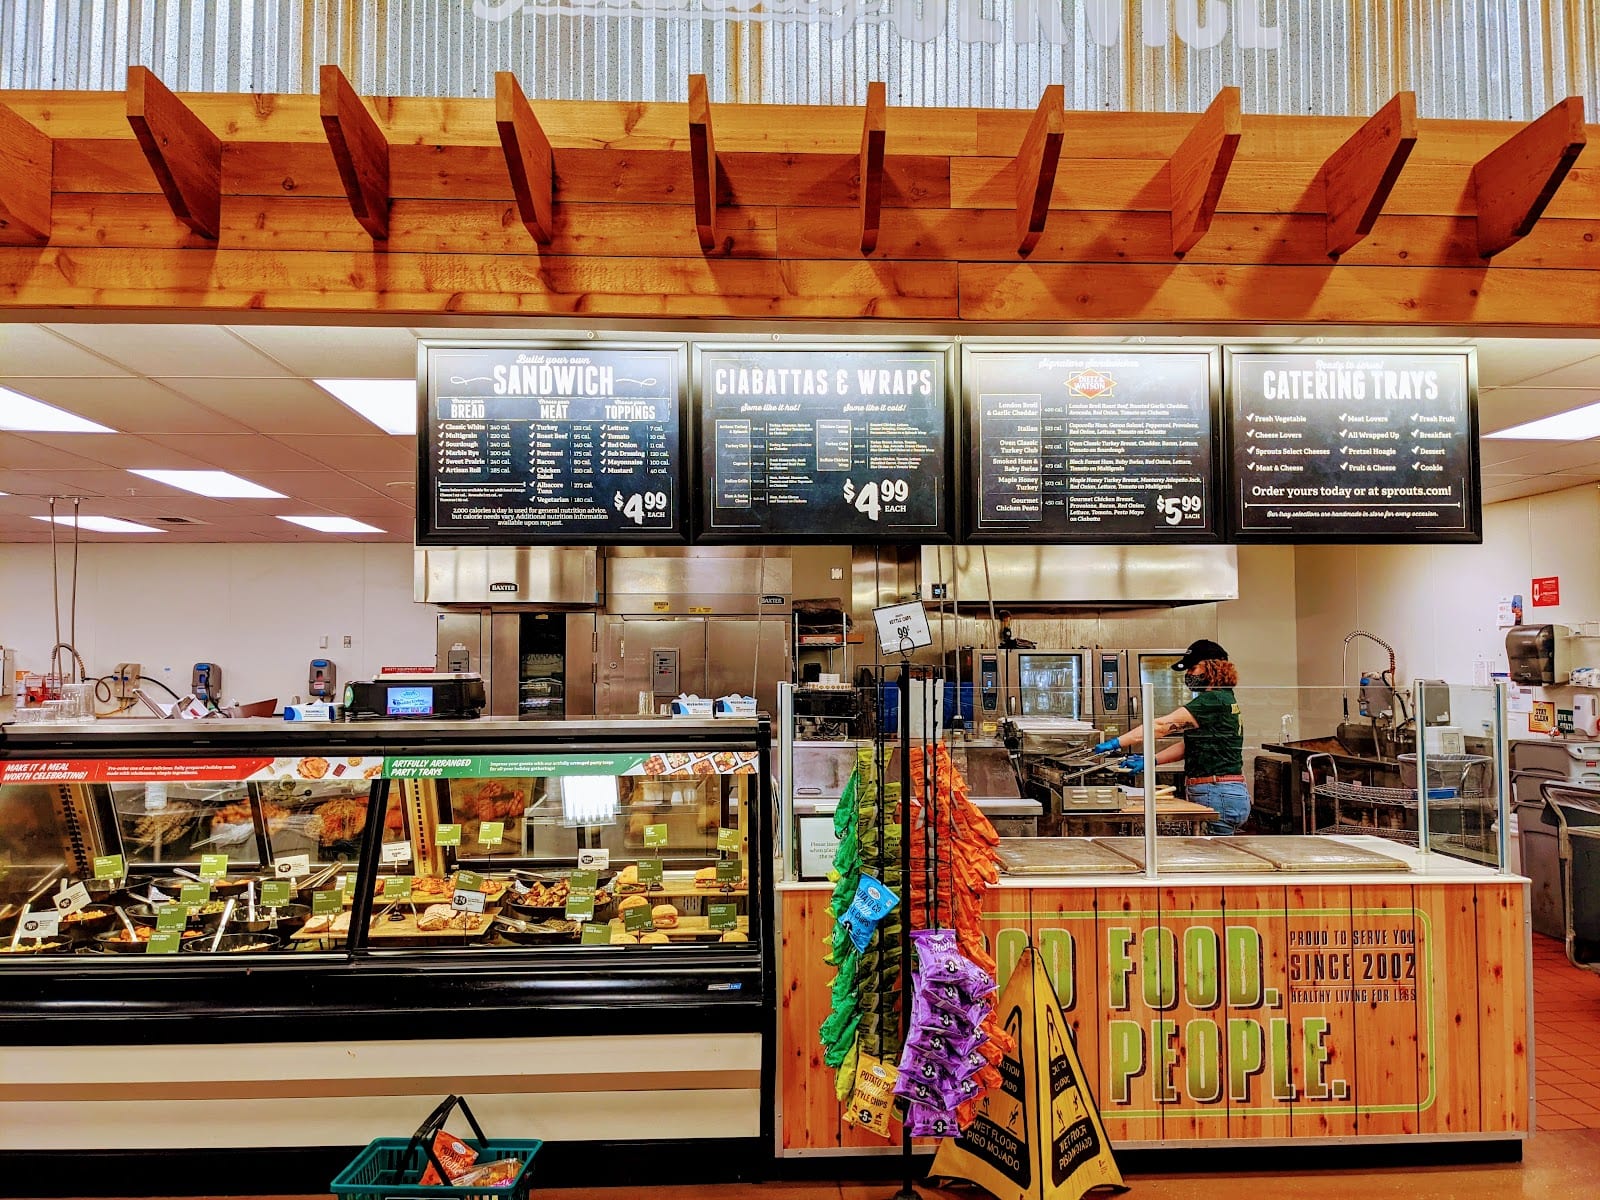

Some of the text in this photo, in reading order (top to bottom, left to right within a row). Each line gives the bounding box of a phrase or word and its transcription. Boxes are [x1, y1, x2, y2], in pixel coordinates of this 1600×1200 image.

[493, 364, 613, 396] SANDWICH
[715, 368, 932, 396] CIABATTAS & WRAPS
[1073, 382, 1105, 390] WATSON
[1263, 370, 1439, 400] CATERING TRAYS
[451, 404, 485, 419] BREAD
[540, 405, 569, 420] MEAT
[605, 405, 656, 420] TOPPINGS
[1275, 416, 1307, 424] Vegetable
[1359, 432, 1389, 440] Wrapped
[1389, 432, 1400, 440] Up
[1256, 448, 1282, 456] Sprouts
[1373, 448, 1397, 456] Hoagie
[1252, 486, 1452, 499] Order yours today or at sprouts.com!
[885, 505, 906, 513] EACH
[5, 763, 70, 772] MAKE IT A MEAL
[392, 758, 472, 768] ARTFULLY ARRANGED
[3, 771, 89, 780] WORTH CELEBRATING!
[391, 768, 443, 777] PARTY TRAYS
[1289, 929, 1415, 946] PROUD TO SERVE YOU
[1107, 926, 1283, 1015] FOOD.
[1290, 952, 1416, 981] SINCE 2002
[1291, 988, 1416, 1003] HEALTHY LIVING FOR LESS
[1108, 1016, 1351, 1105] PEOPLE.
[860, 1070, 882, 1088] POTATO
[870, 1096, 888, 1110] CHIPS
[973, 1119, 1018, 1155] WET FLOOR
[966, 1130, 1020, 1171] PISO MOJADO
